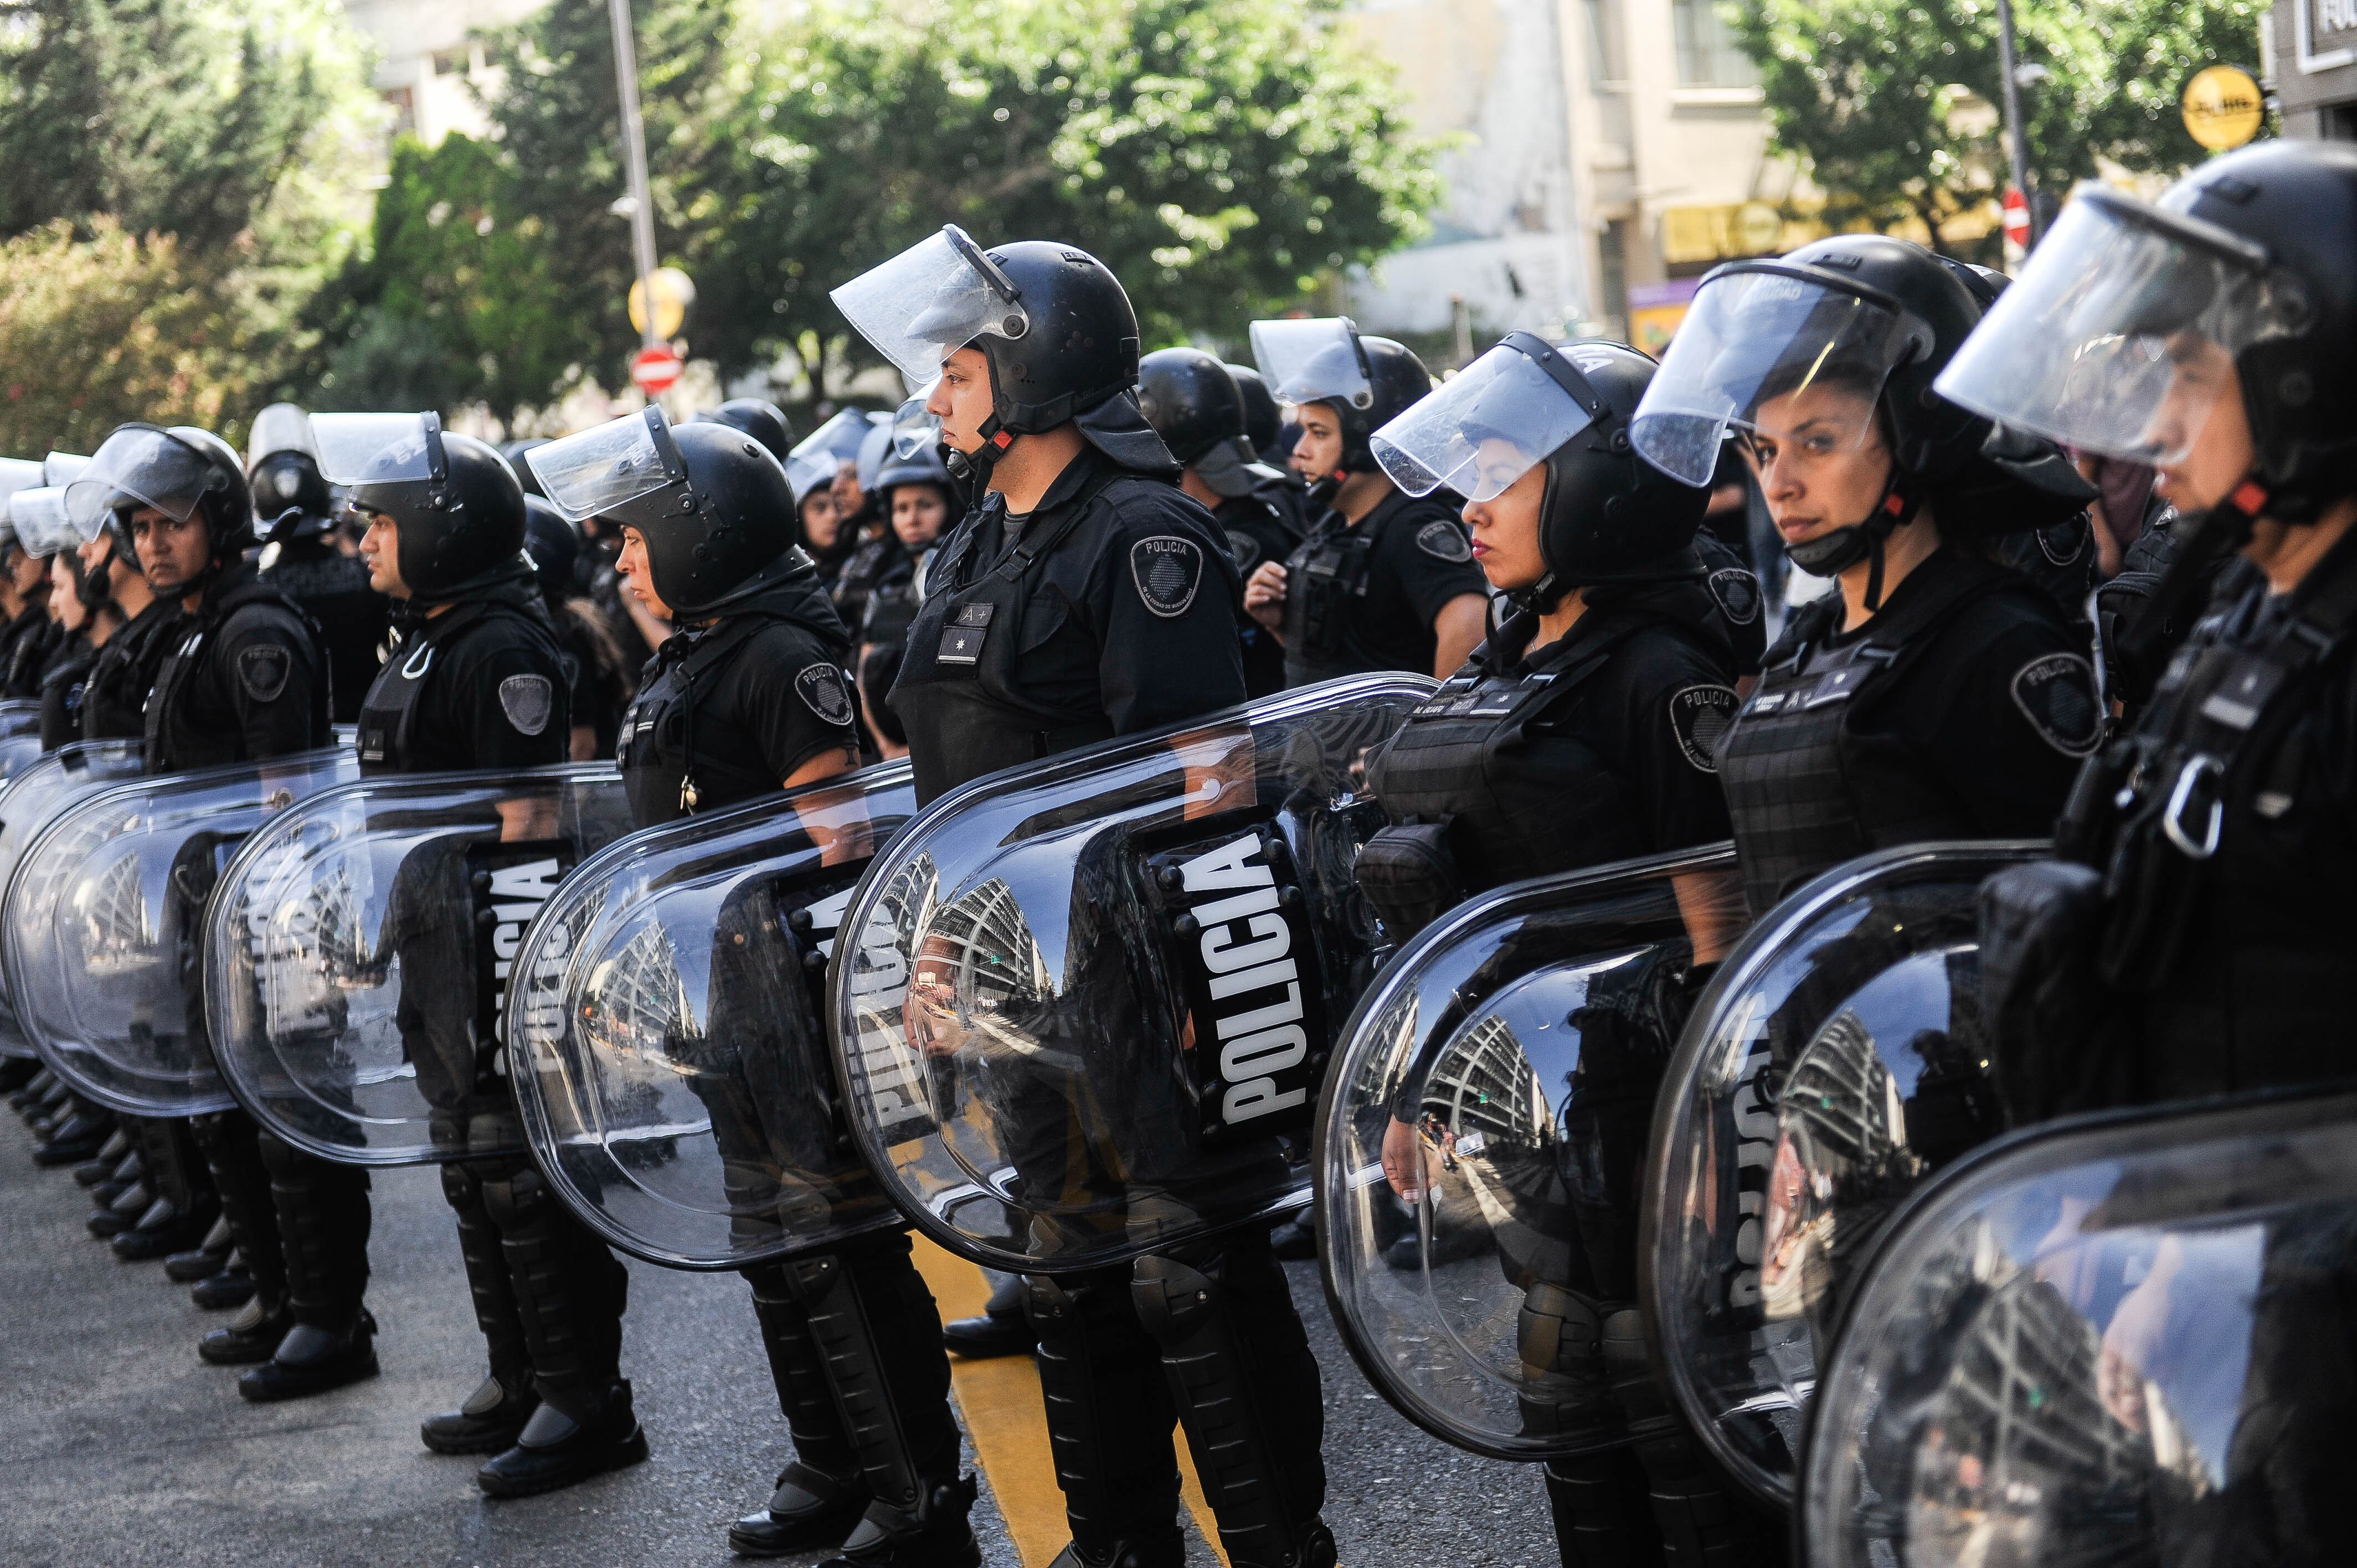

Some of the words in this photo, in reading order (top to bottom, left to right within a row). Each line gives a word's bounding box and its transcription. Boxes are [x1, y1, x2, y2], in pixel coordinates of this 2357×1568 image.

[1145, 541, 1187, 556] POLICIA
[802, 667, 833, 685] POLICIA
[1685, 691, 1730, 709] POLICIA
[1179, 833, 1306, 1125] POLICIA
